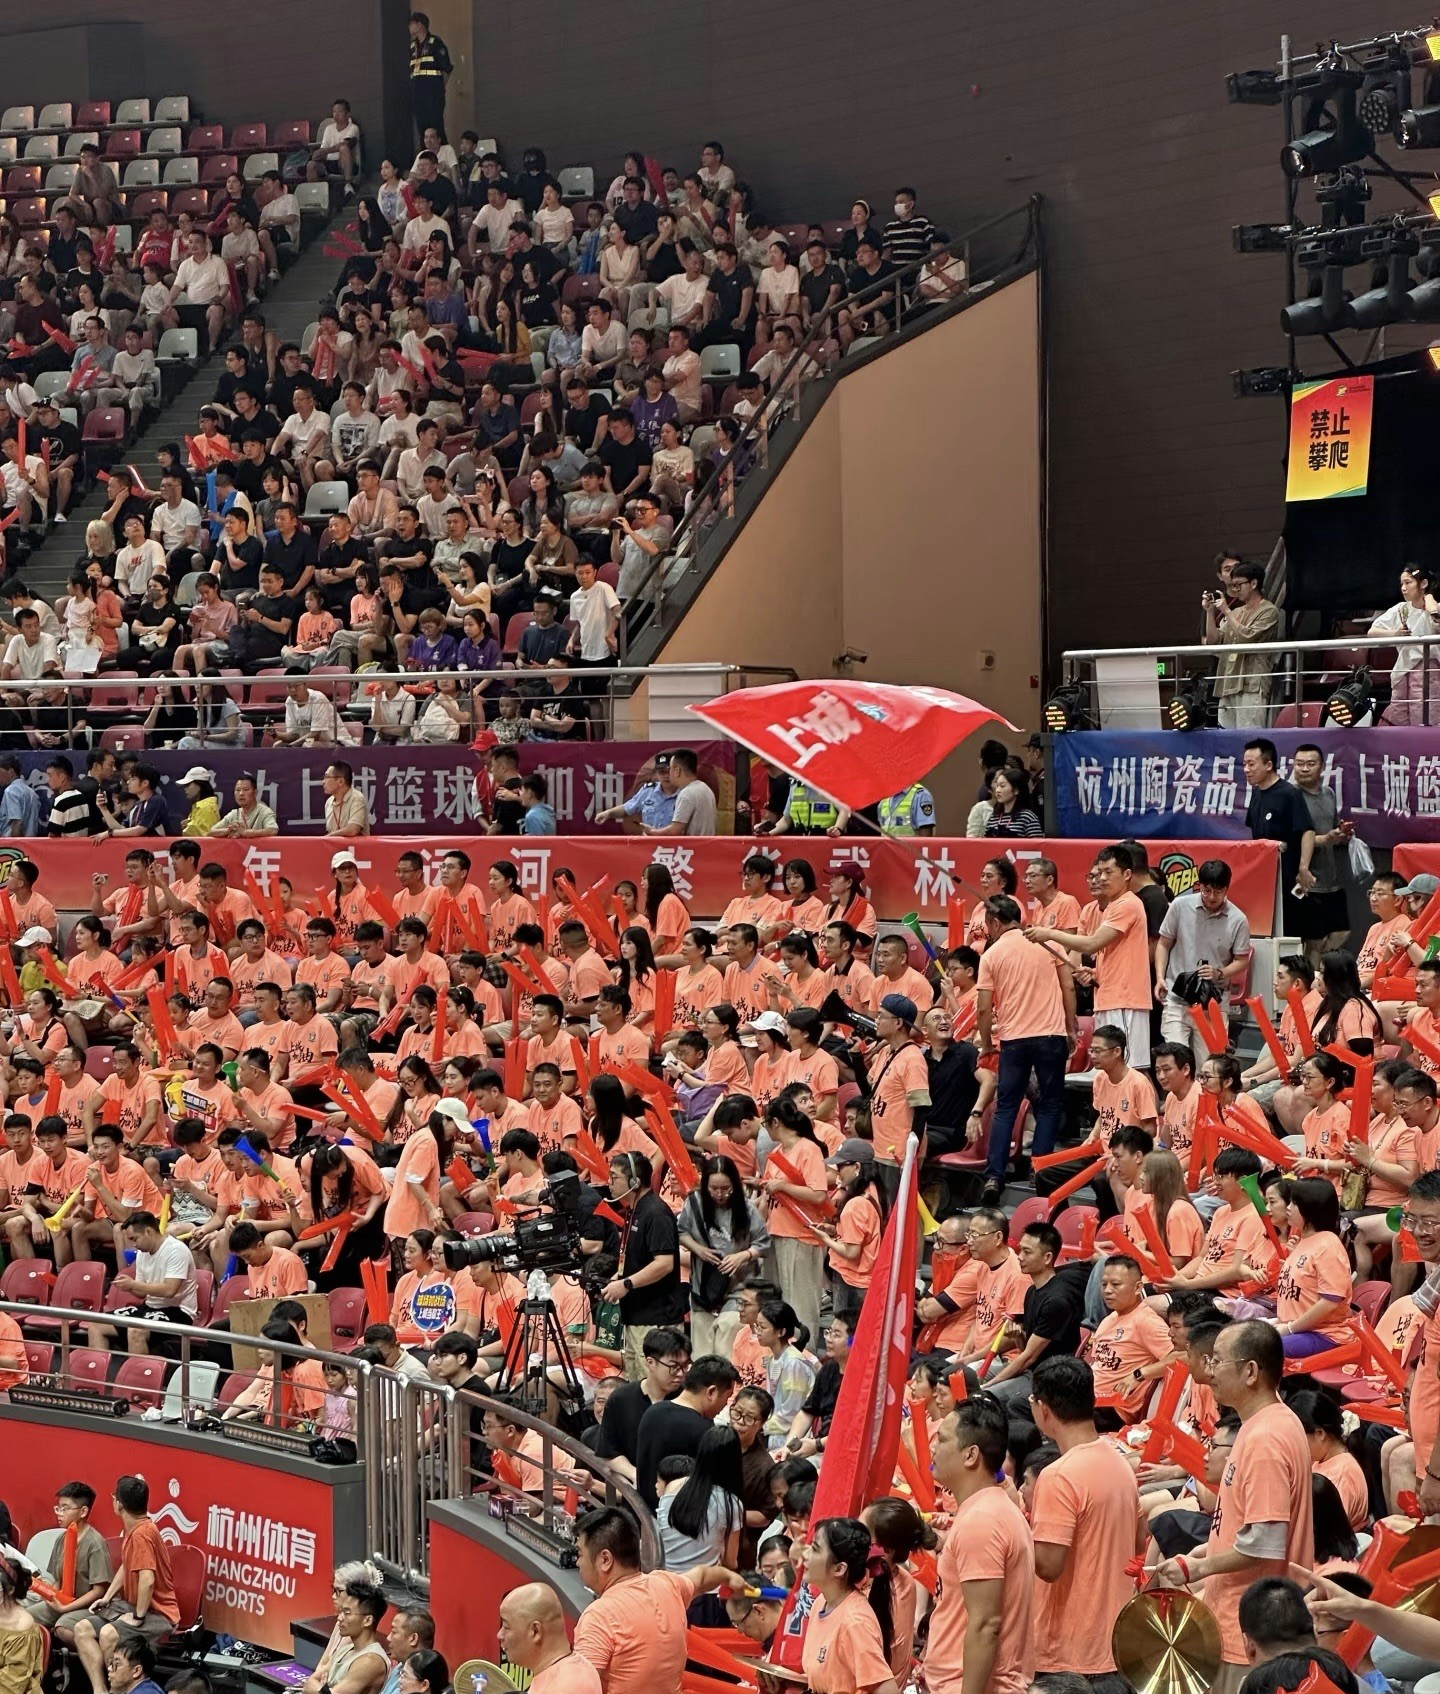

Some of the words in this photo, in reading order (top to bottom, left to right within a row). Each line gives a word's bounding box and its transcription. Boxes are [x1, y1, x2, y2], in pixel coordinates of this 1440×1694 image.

[1310, 407, 1350, 438] 禁止
[1308, 440, 1349, 471] 攀爬
[206, 1504, 317, 1575] 杭州体育
[206, 1554, 297, 1599] HANGZHOU
[205, 1580, 266, 1617] SPORTS
